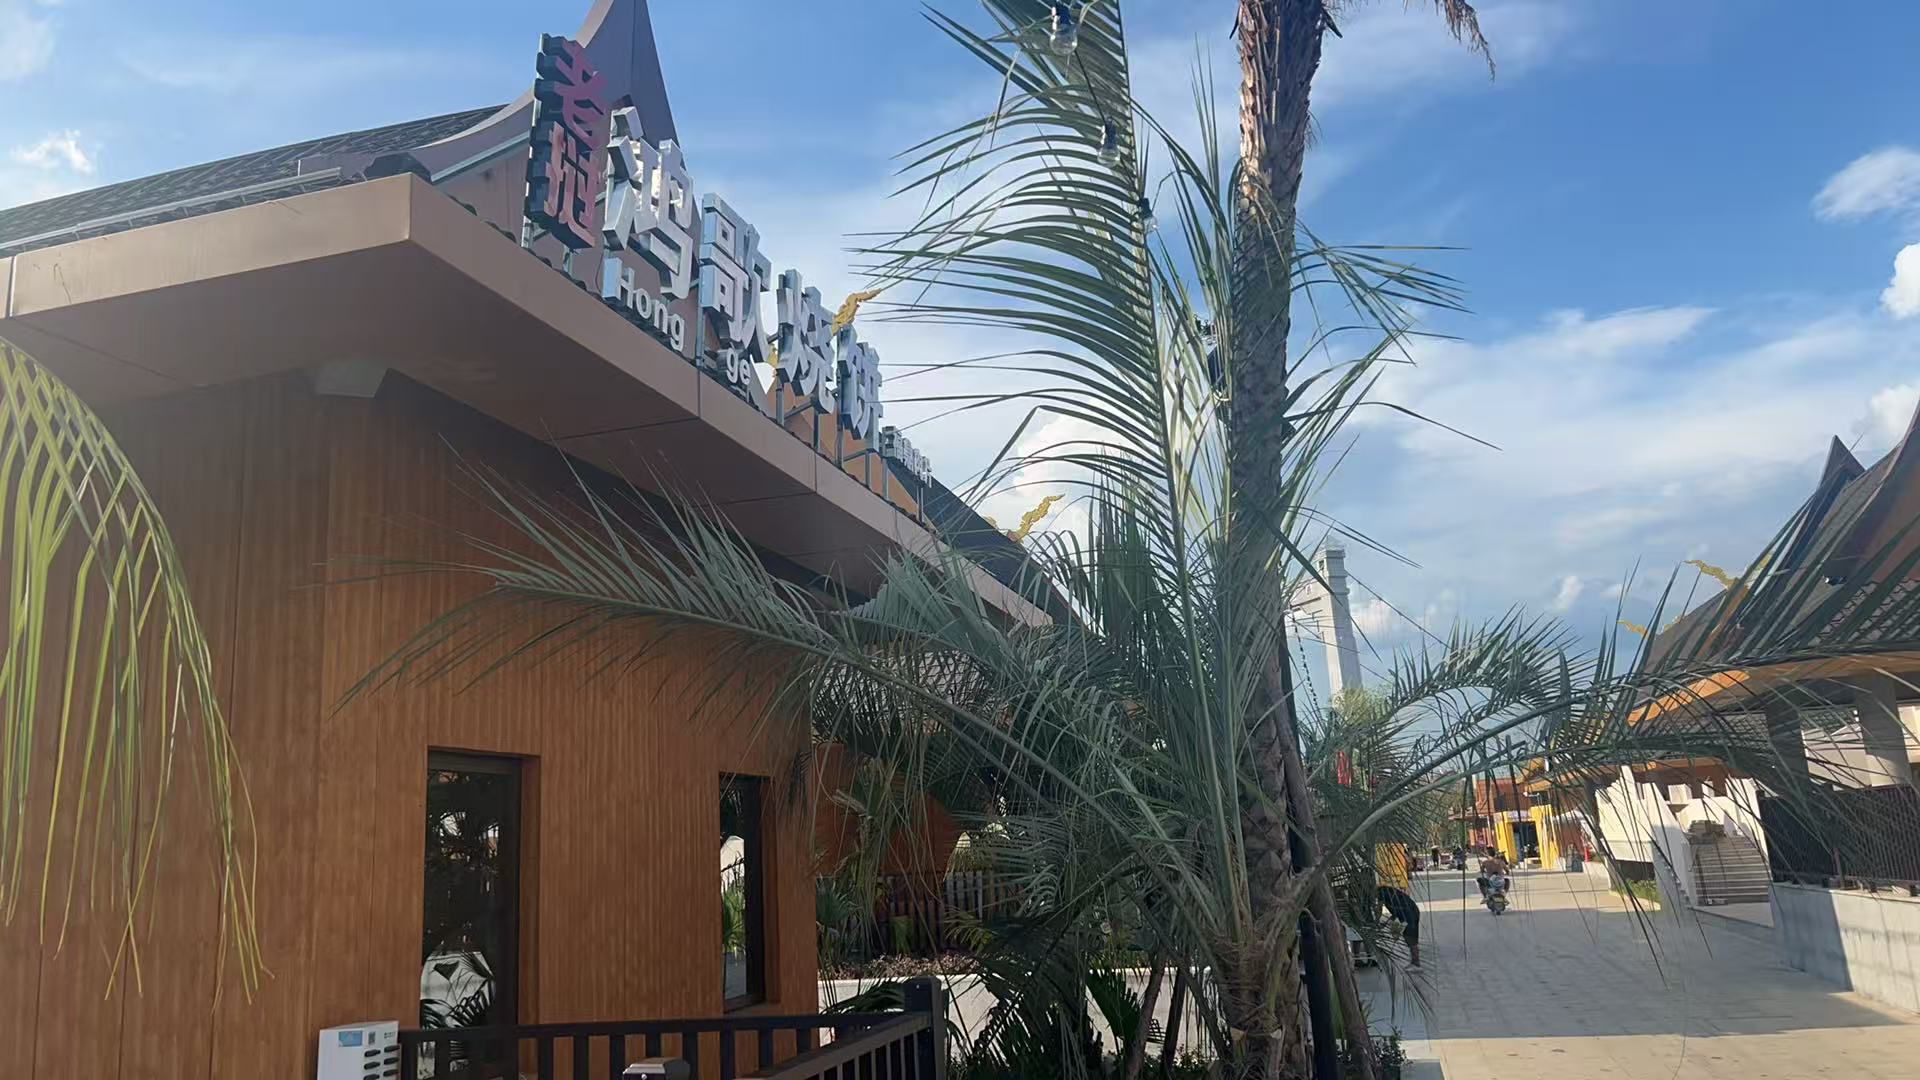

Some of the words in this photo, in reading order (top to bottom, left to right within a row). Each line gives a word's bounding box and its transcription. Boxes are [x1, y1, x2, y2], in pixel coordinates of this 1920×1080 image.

[530, 33, 608, 248] 老挝
[602, 106, 883, 452] 鸿歌烧饼
[604, 256, 685, 352] Hong
[725, 346, 751, 386] ge
